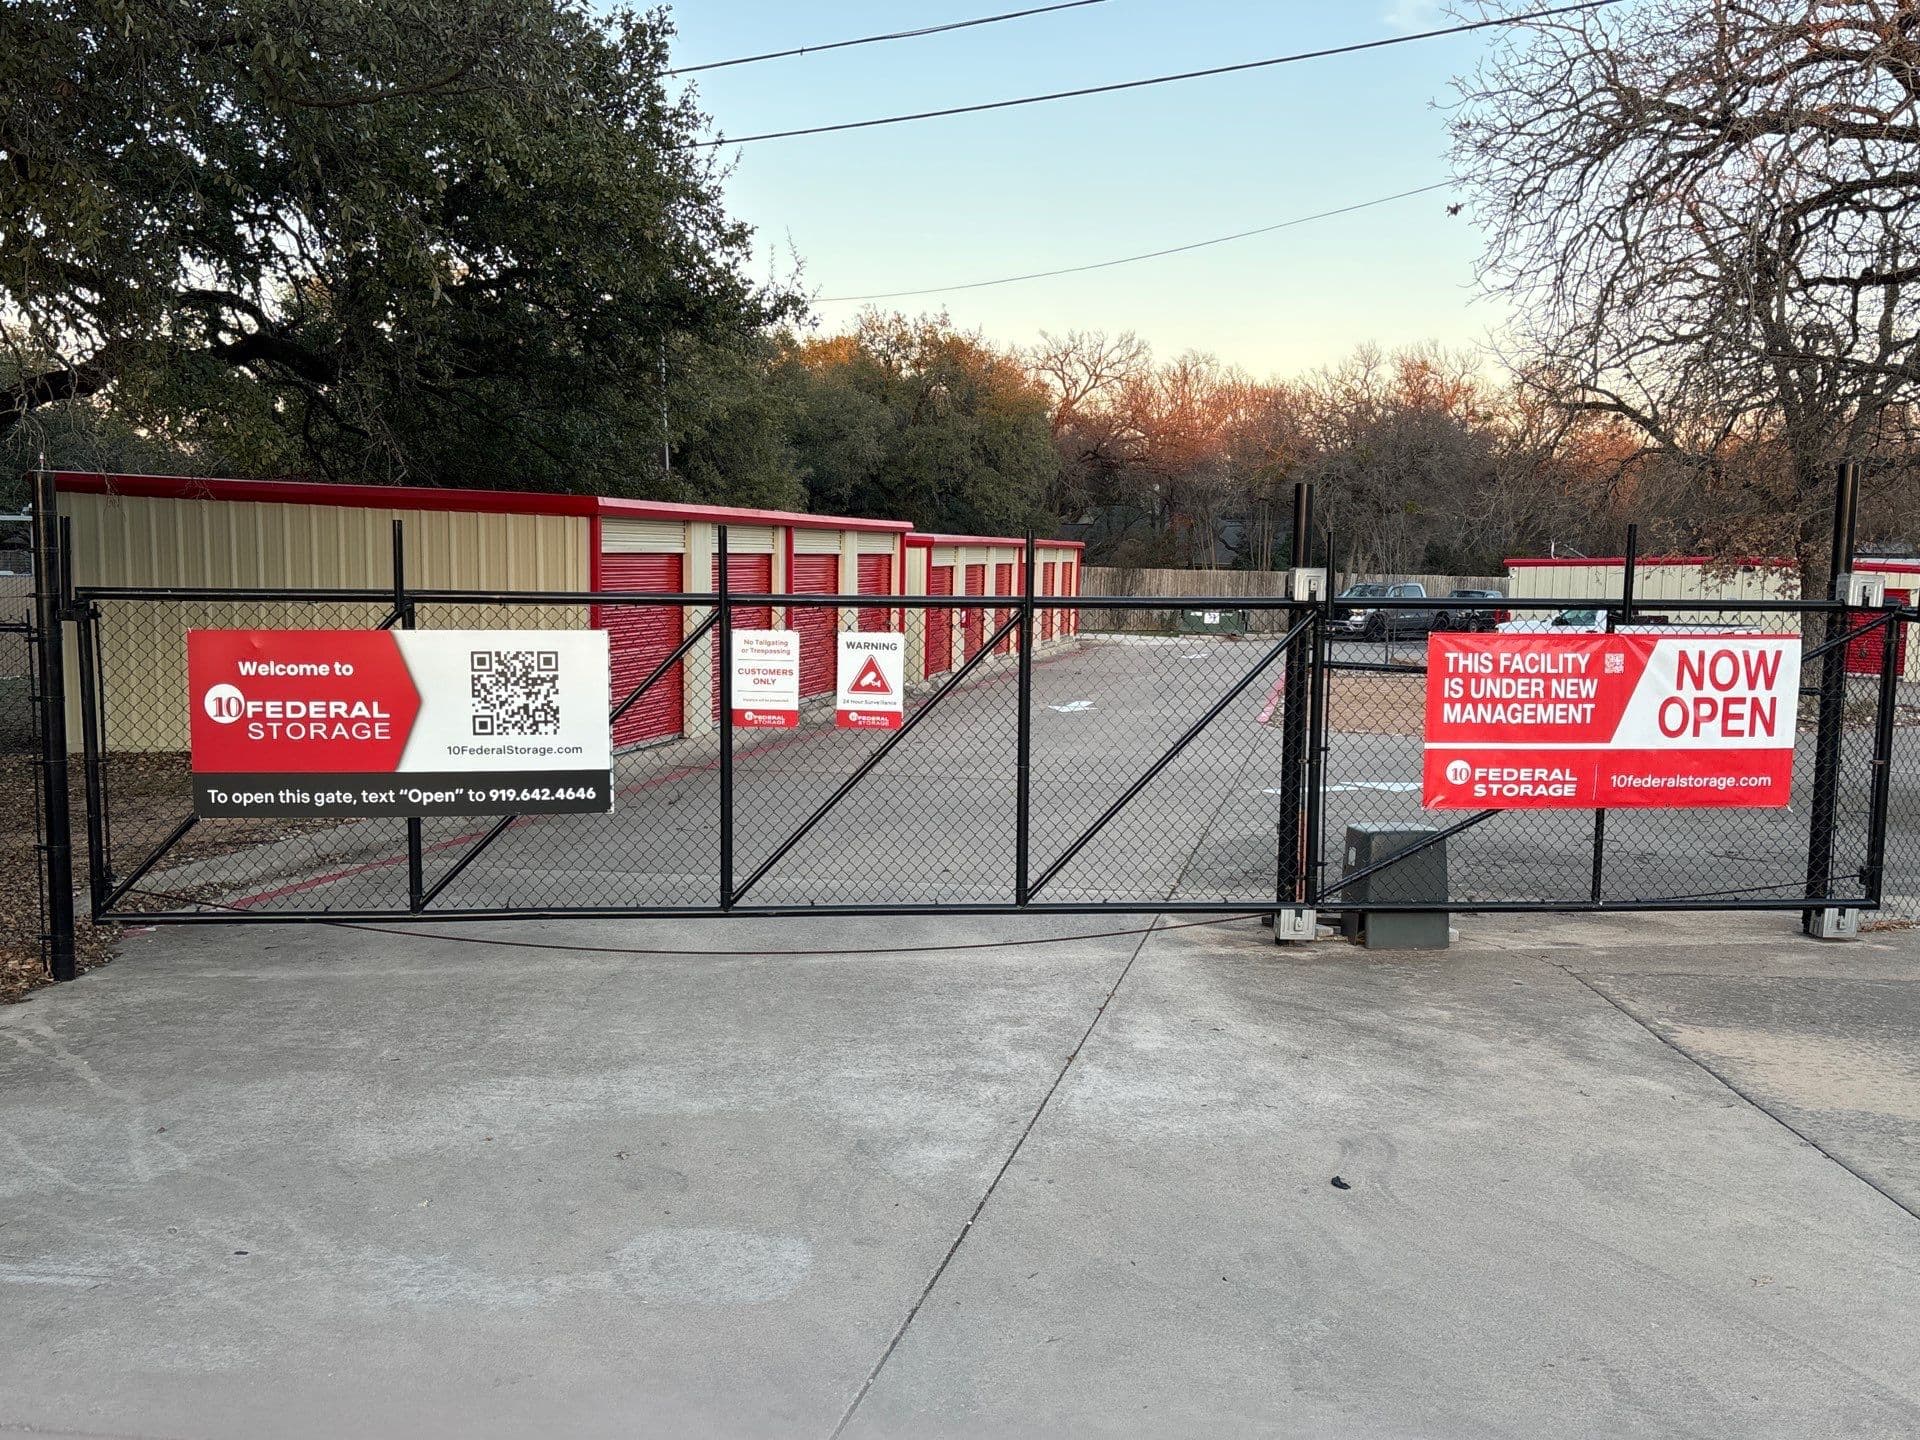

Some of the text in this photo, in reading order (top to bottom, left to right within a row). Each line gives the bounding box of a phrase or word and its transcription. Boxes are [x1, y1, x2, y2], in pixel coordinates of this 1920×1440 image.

[750, 647, 791, 656] Trespassing
[755, 639, 789, 647] Tailgating
[846, 641, 898, 651] WARNING
[237, 660, 355, 677] Welcome to
[1444, 652, 1591, 674] THIS FACILITY
[1676, 649, 1783, 692] NOW
[737, 668, 794, 676] CUSTOMERS
[1443, 677, 1599, 699] IS UNDER NEW
[212, 696, 391, 718] 10 FEDERAL
[1442, 702, 1596, 724] MANAGEMENT
[1658, 696, 1778, 738] OPEN
[248, 722, 391, 740] STORAGE
[446, 744, 583, 757] 10FederalStorage.com
[1451, 767, 1578, 782] 10 FEDERAL
[1610, 774, 1773, 790] 10federalstorage.com
[207, 789, 228, 804] To
[232, 791, 275, 807] open
[278, 789, 311, 804] this
[314, 790, 358, 807] gate,
[361, 789, 396, 803] text
[467, 789, 486, 802] to
[489, 786, 597, 802] 919.642.4646
[1473, 783, 1578, 797] STORAGE
